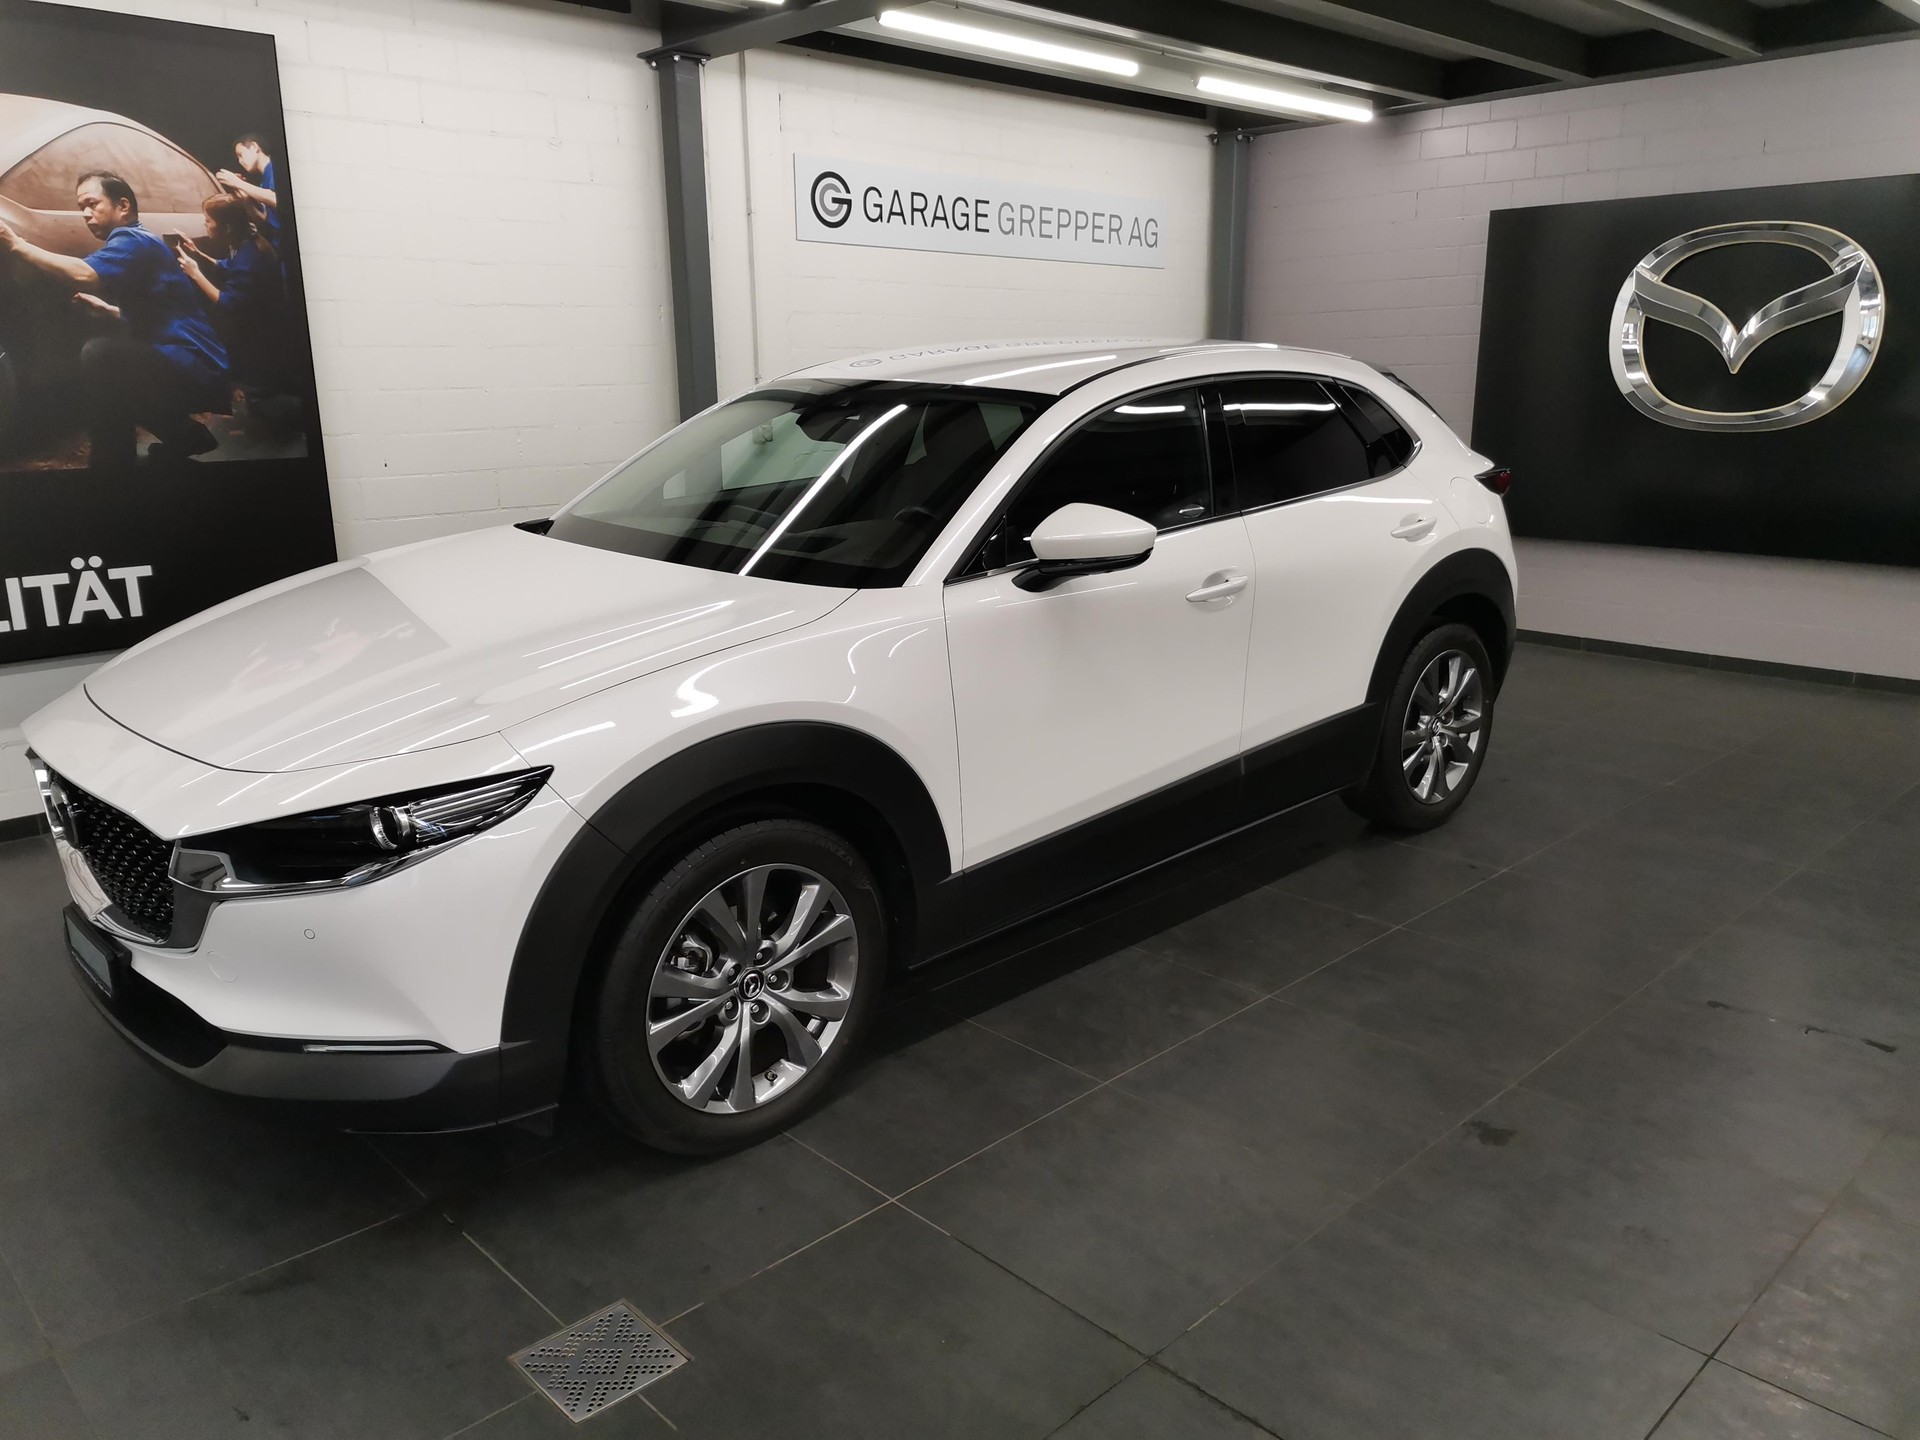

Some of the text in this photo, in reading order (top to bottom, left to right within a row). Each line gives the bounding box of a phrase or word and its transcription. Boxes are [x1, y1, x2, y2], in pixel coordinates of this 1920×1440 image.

[862, 186, 990, 233] GARAGE
[997, 201, 1123, 246] GREPPER
[1127, 216, 1159, 249] AG
[0, 555, 153, 633] ITÄT
